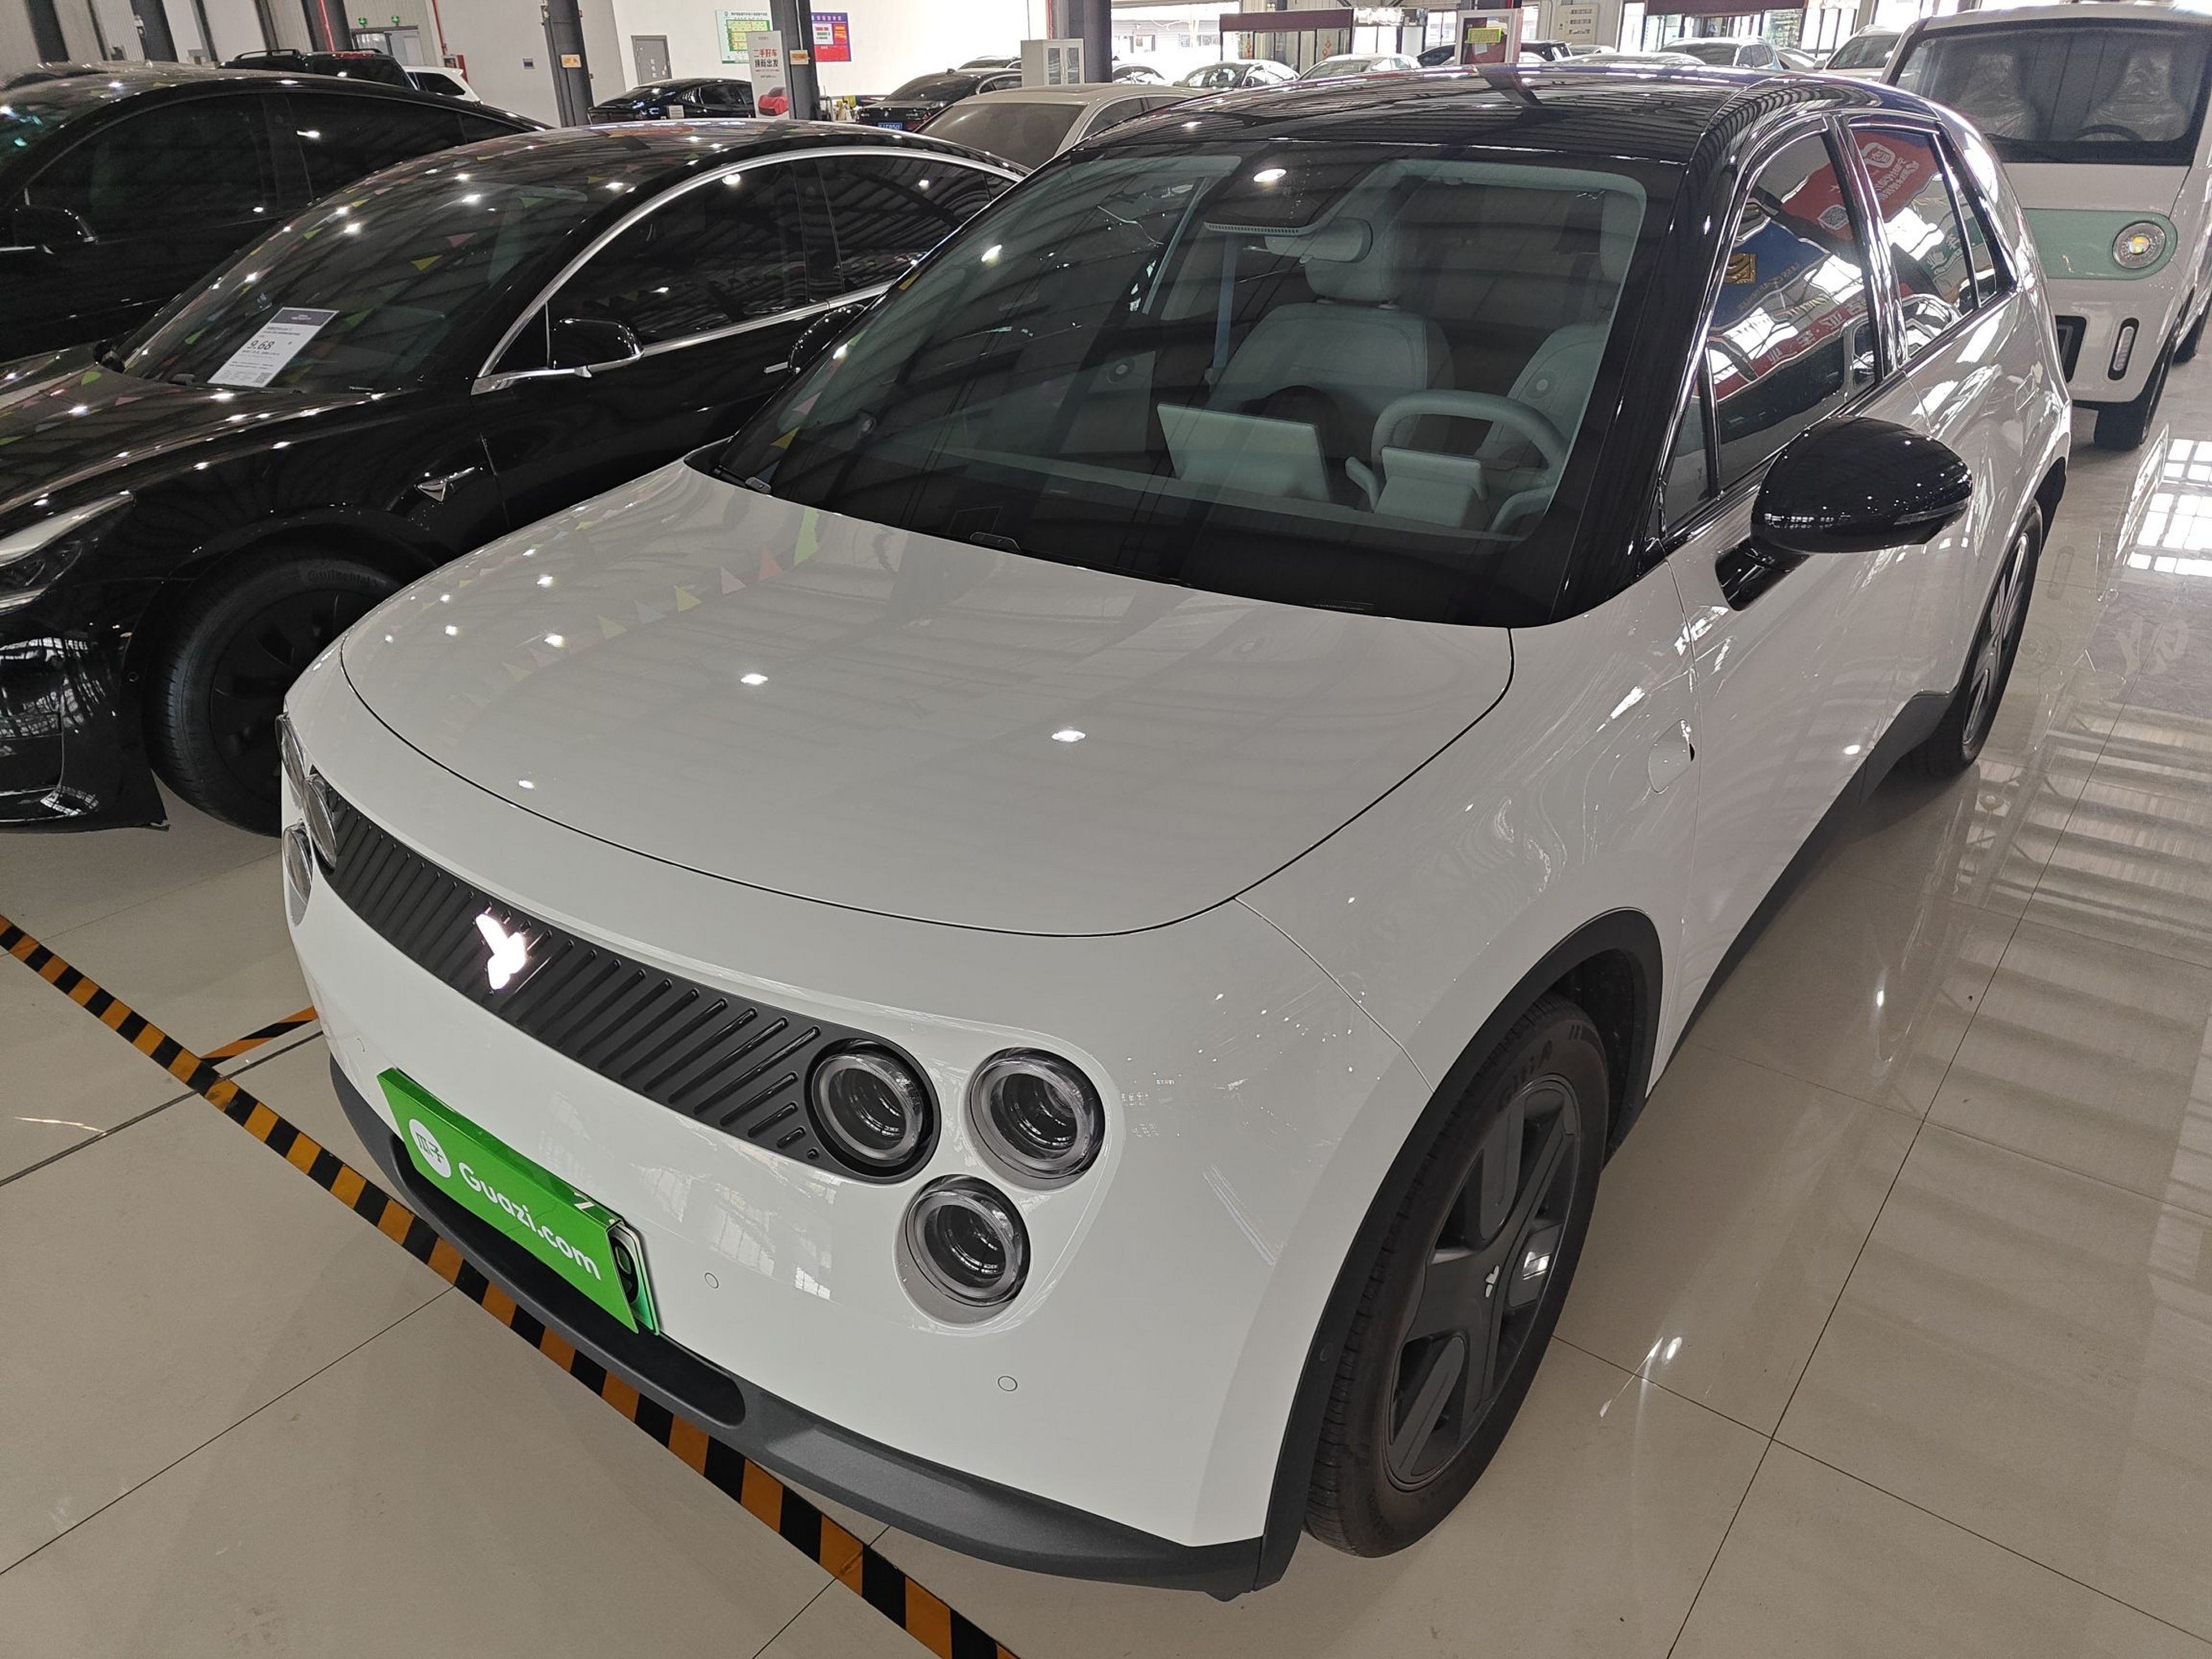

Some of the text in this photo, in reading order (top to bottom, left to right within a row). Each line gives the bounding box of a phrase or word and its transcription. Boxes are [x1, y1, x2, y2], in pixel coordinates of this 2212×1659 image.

[753, 48, 778, 58] 二手好车
[247, 340, 275, 350] 9.68
[415, 1130, 445, 1165] 瓜子
[459, 1162, 601, 1282] Guazi.com
